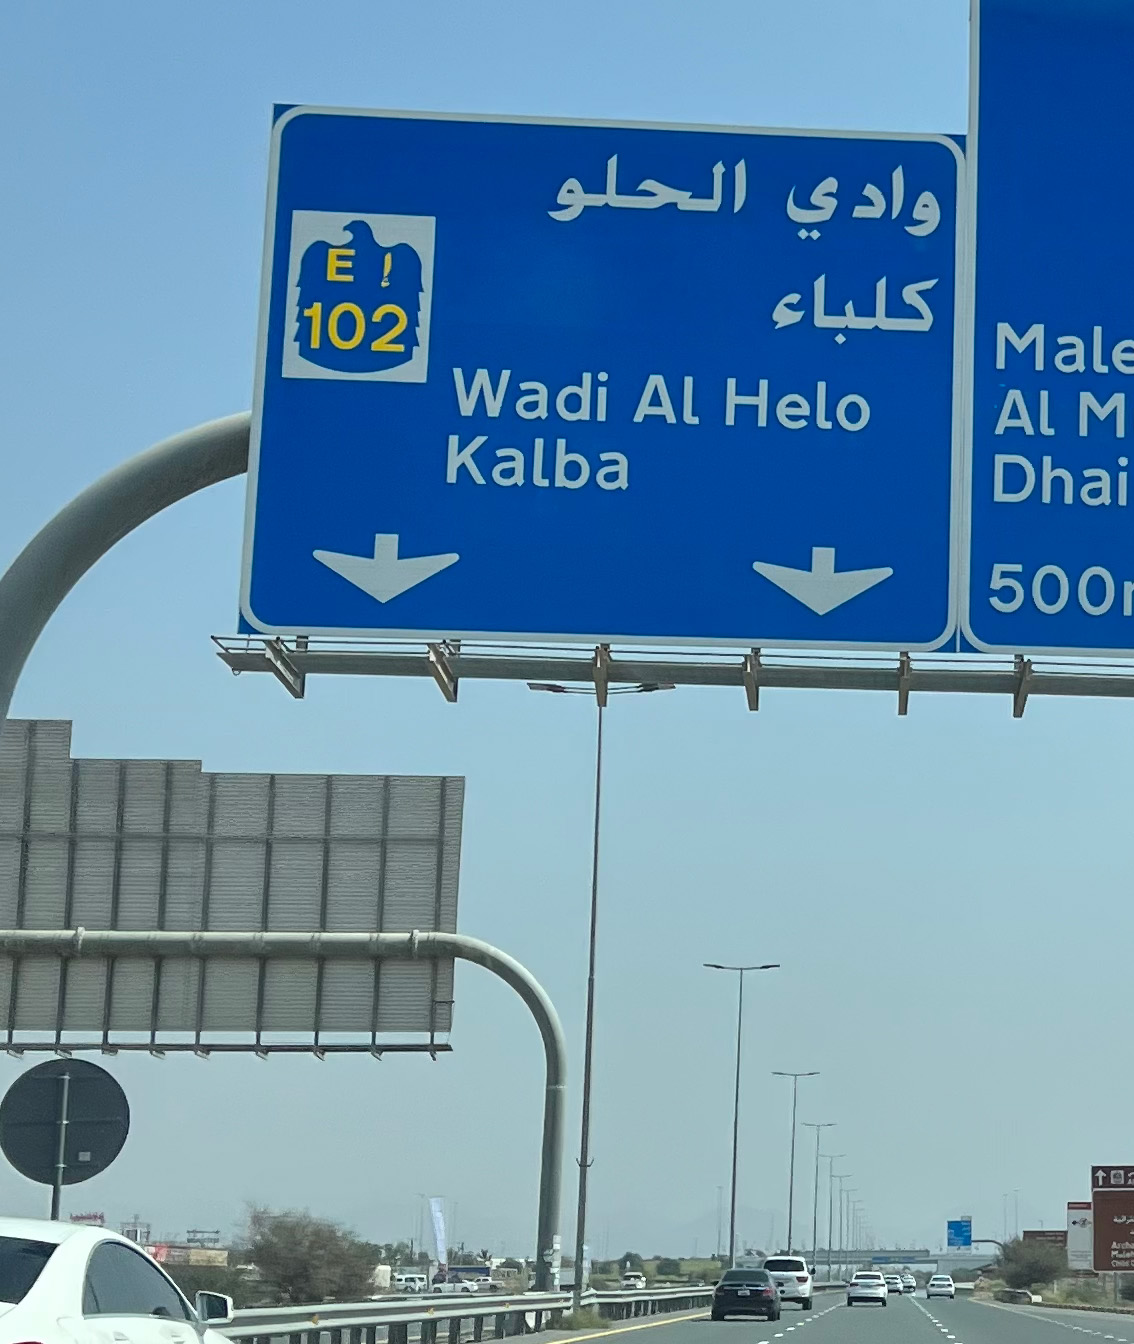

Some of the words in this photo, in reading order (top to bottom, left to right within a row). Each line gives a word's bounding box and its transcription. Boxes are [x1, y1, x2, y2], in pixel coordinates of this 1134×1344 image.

[547, 153, 747, 222] الحلو
[786, 165, 941, 241] وادي
[326, 248, 356, 282] E
[303, 301, 408, 353] 102
[772, 273, 939, 345] كلباء
[452, 367, 609, 422] Wadi
[632, 374, 700, 425] Al
[725, 377, 871, 432] Helo
[994, 389, 1055, 436] Al
[446, 434, 629, 491] Kalba
